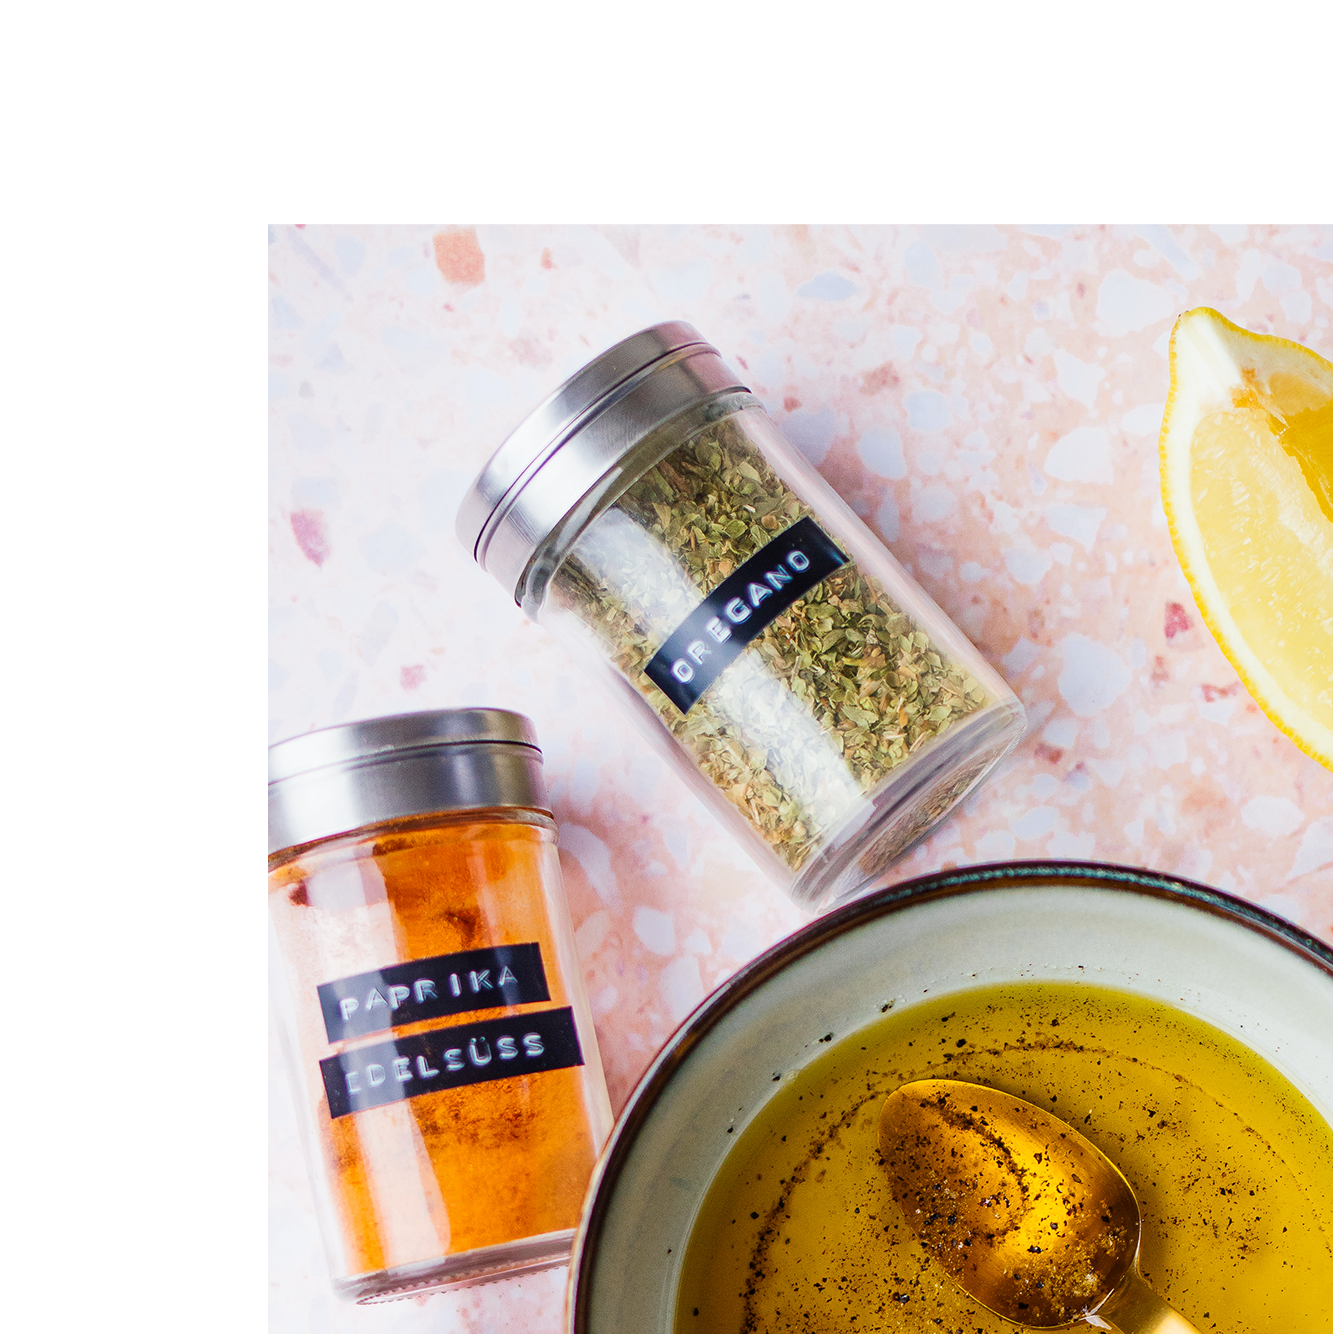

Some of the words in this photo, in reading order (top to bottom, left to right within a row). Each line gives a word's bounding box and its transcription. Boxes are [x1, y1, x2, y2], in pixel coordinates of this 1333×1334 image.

[671, 550, 811, 684] OREGANO
[339, 966, 519, 1021] PAPRIKA
[345, 1033, 546, 1095] EDELSÜSS
